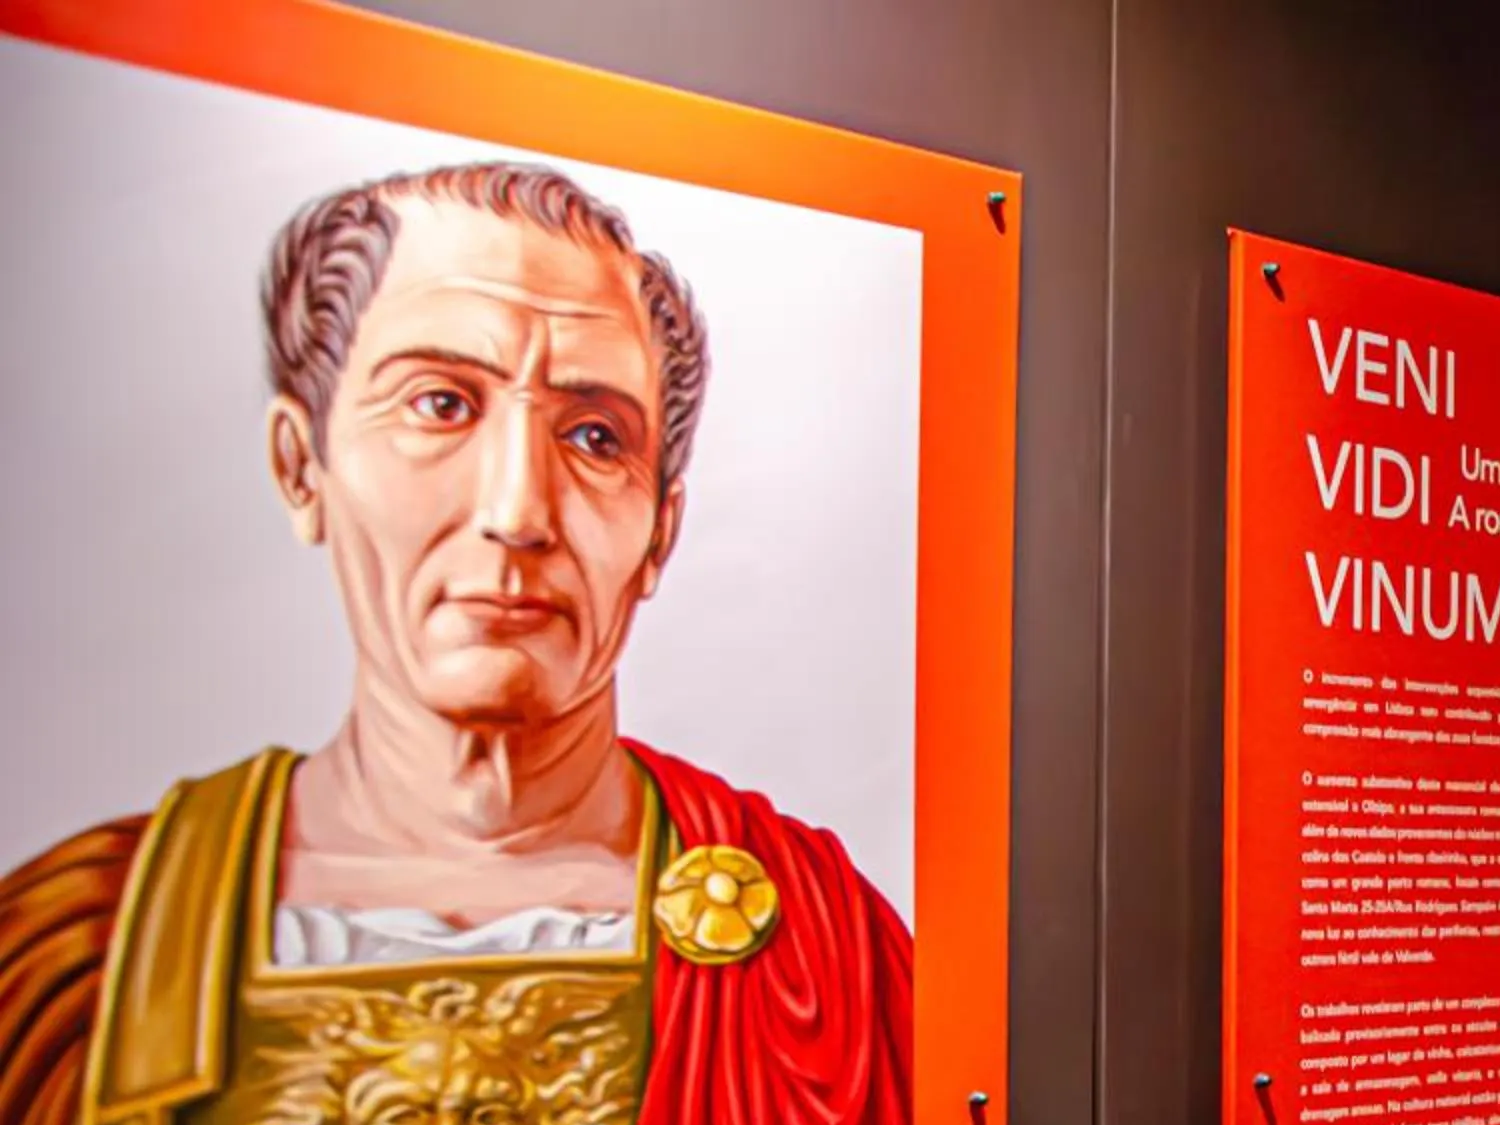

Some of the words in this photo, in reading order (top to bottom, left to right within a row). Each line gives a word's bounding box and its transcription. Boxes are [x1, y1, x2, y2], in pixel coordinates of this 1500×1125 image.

[1308, 320, 1454, 417] VENI
[1307, 435, 1429, 523] VIDI
[1448, 495, 1470, 531] A
